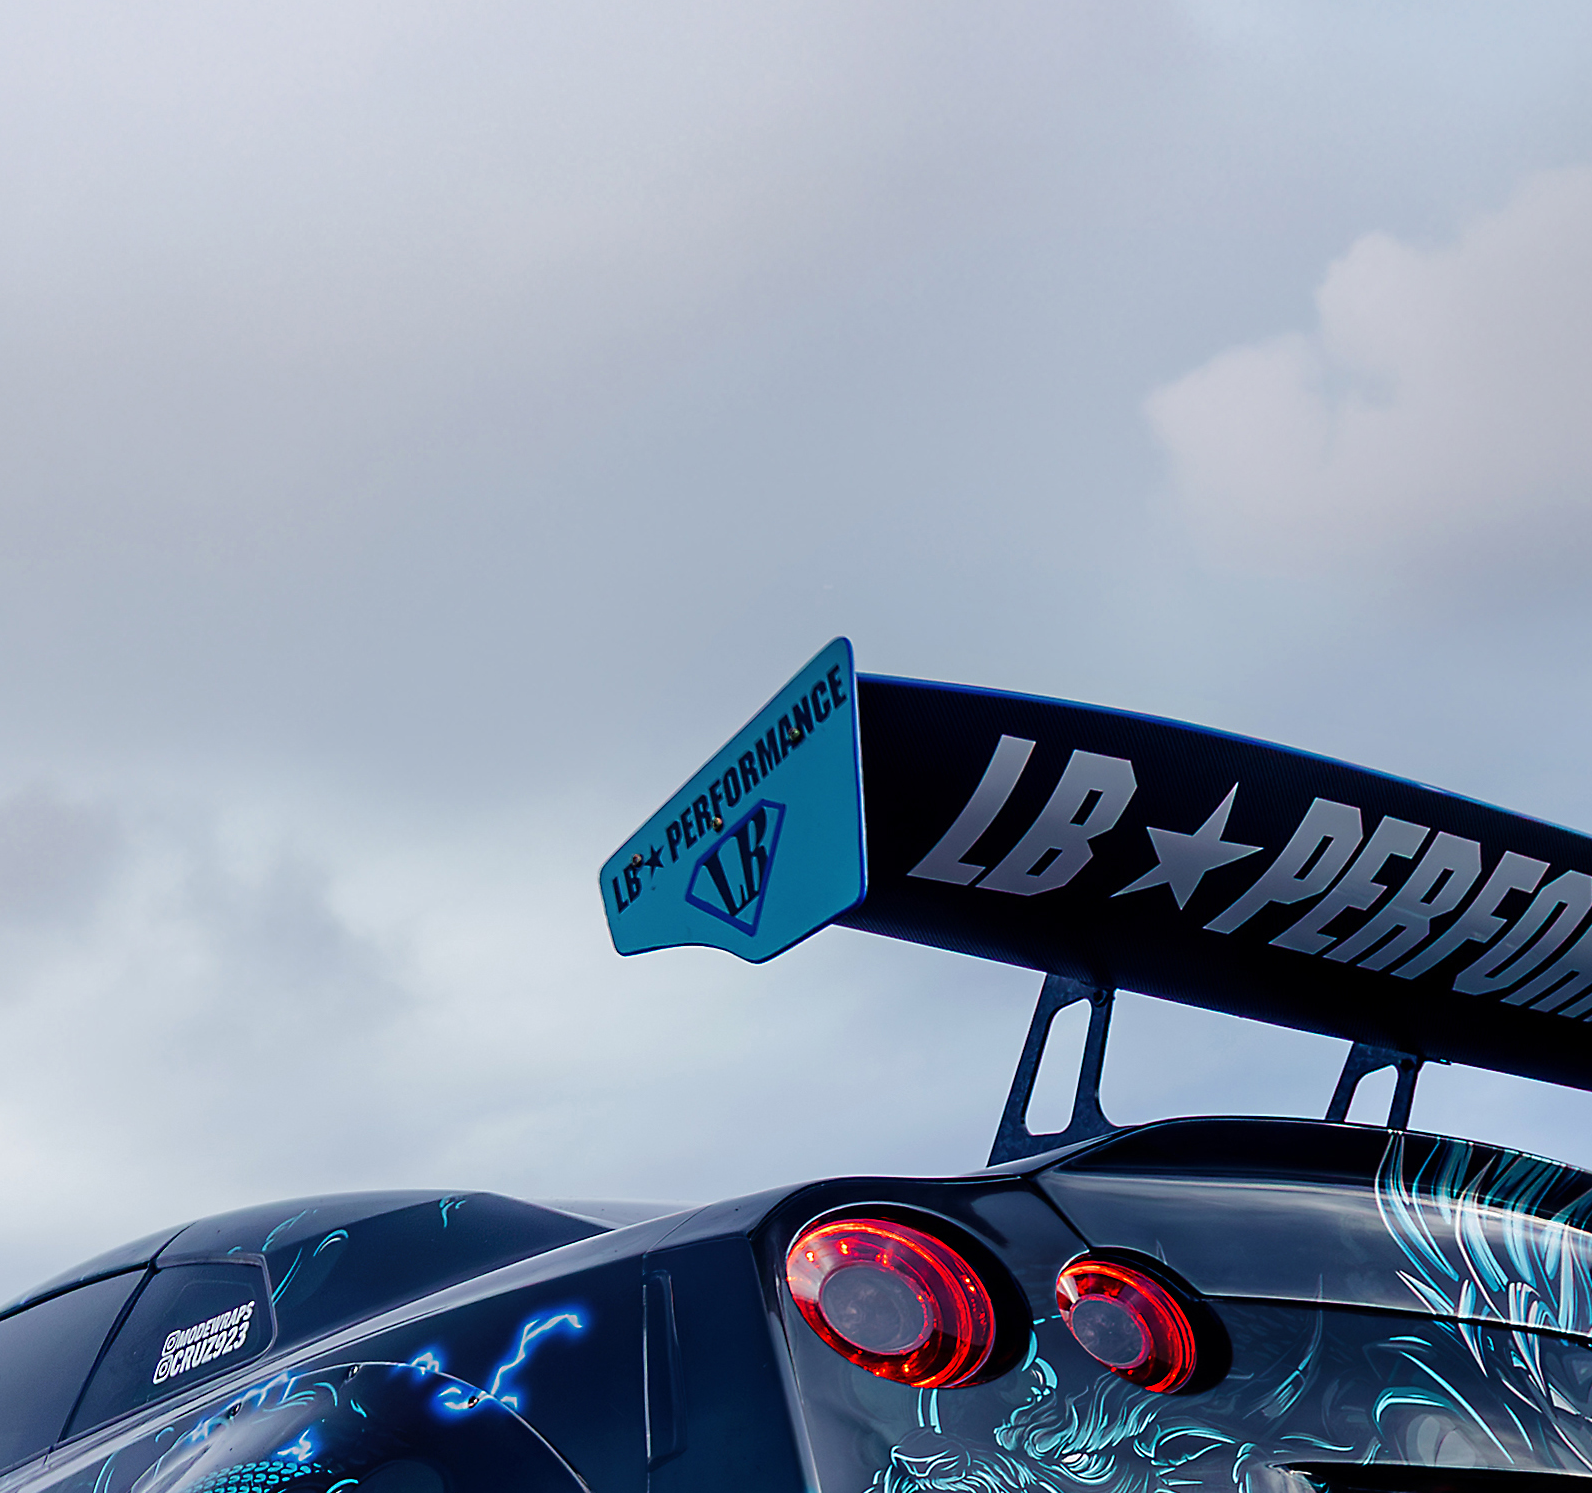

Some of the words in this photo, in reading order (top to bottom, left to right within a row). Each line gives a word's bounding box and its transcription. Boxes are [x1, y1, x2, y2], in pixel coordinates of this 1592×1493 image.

[611, 861, 643, 914] LB
[665, 663, 847, 863] PERFORMANCE
[906, 734, 1138, 896] LB
